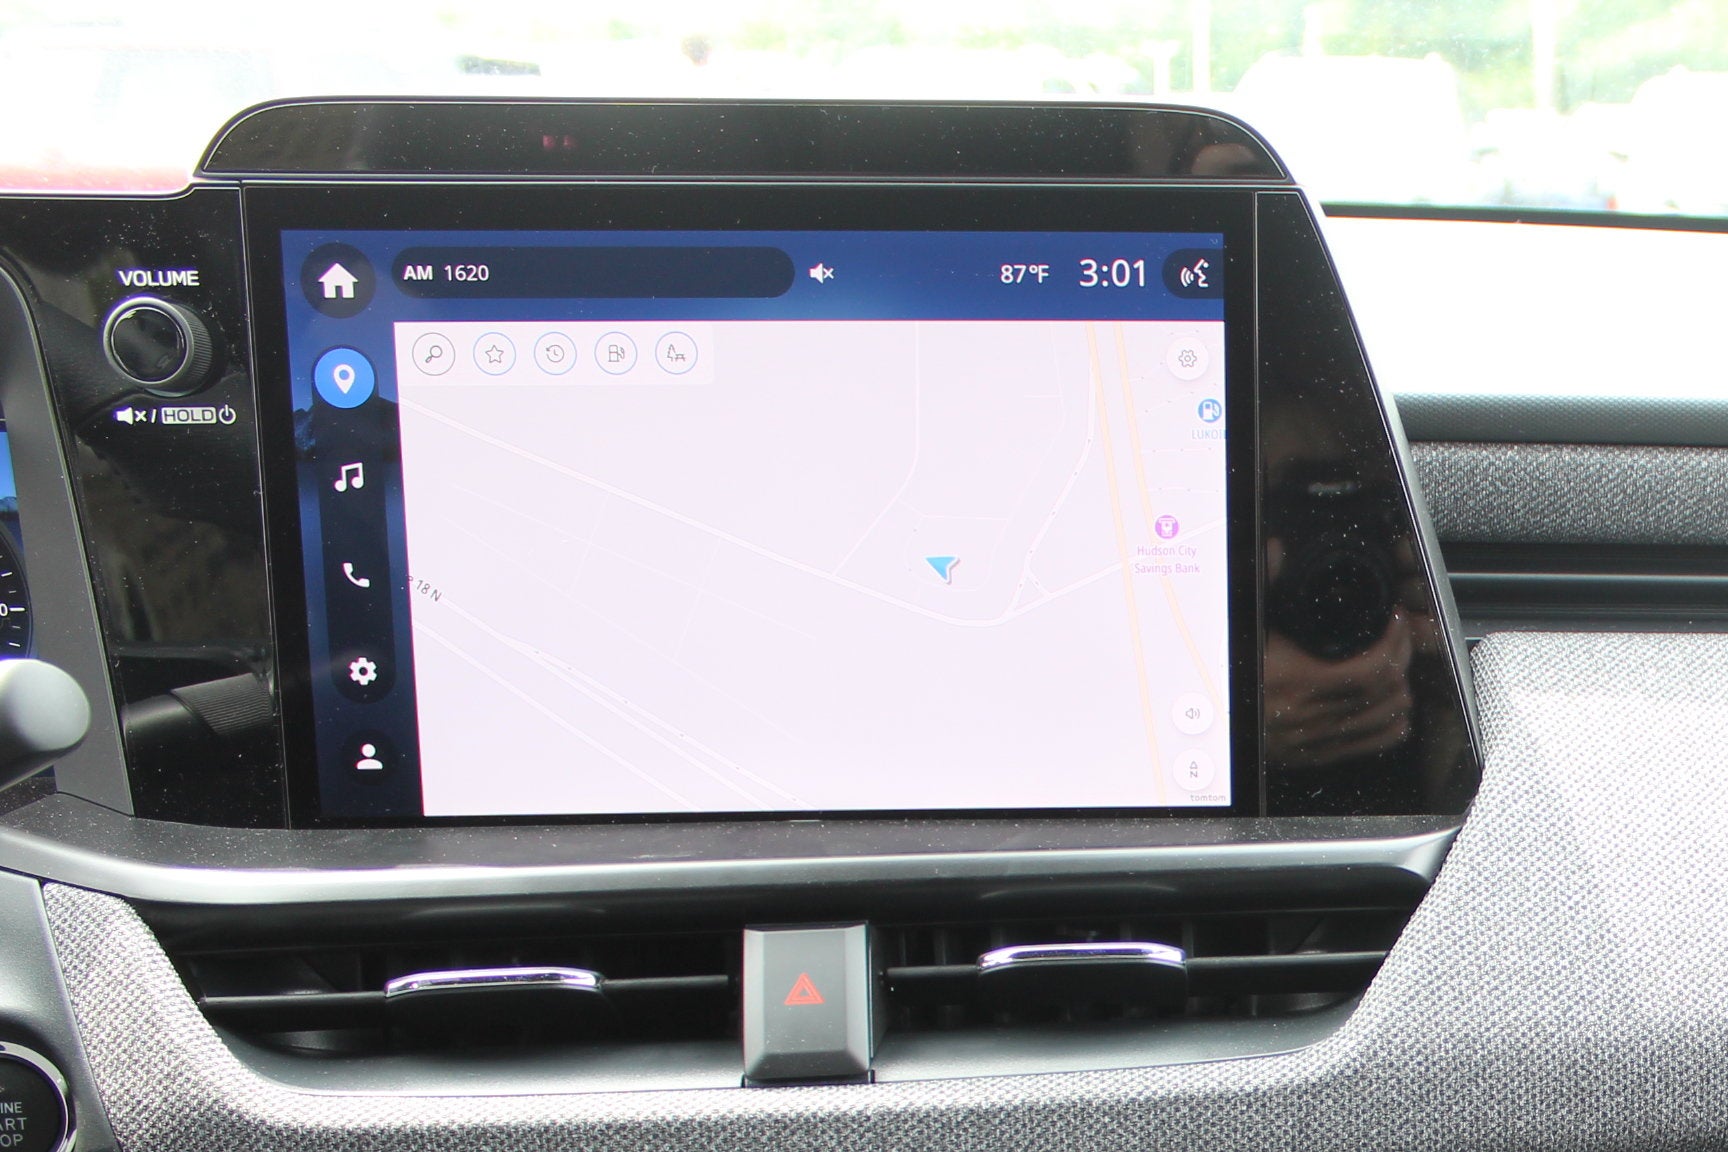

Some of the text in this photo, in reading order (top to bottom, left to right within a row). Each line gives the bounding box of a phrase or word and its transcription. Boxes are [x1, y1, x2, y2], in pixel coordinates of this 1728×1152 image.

[118, 270, 200, 287] VOLUME
[403, 264, 489, 281] AM 1620
[1000, 264, 1049, 284] 87°F
[1079, 258, 1145, 287] 3:01
[163, 409, 214, 422] HOLD
[1137, 545, 1198, 558] Hudson City
[1134, 563, 1200, 576] Savings Bank
